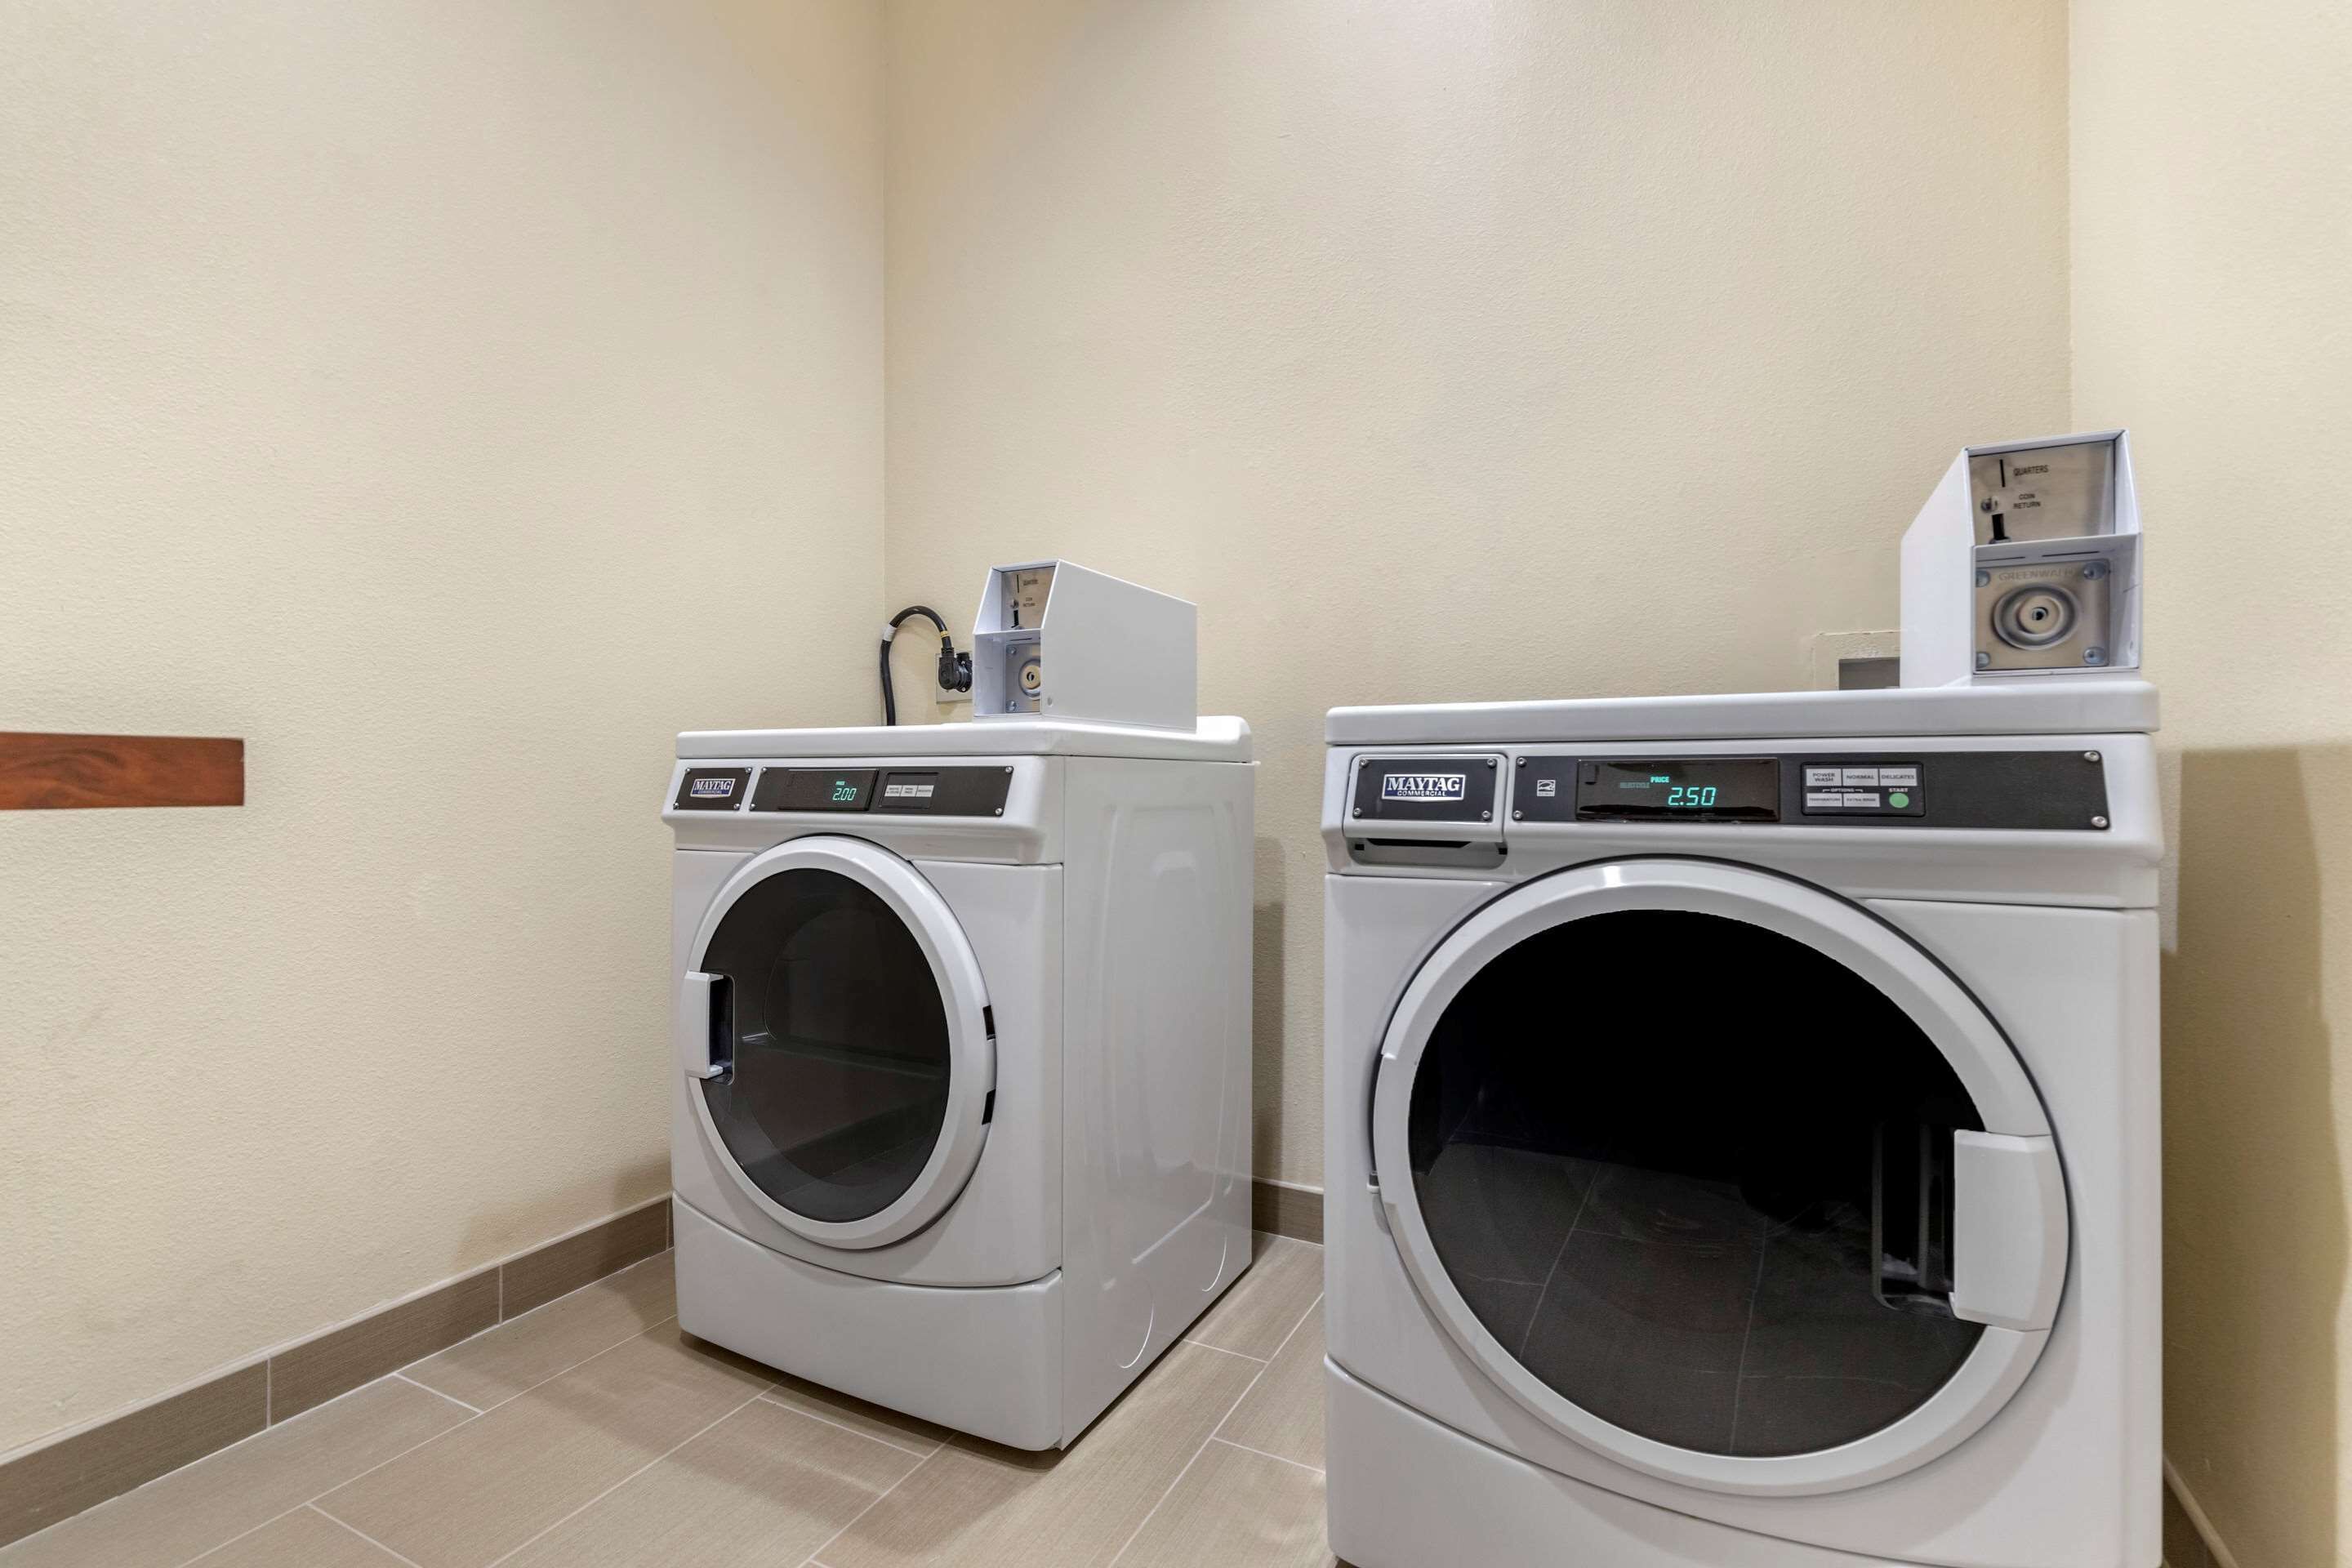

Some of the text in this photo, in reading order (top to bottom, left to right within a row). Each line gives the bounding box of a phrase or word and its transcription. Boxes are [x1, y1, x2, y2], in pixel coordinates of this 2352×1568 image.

[2013, 465, 2049, 476] QUARTERS
[694, 781, 732, 791] MAYTAG
[1387, 777, 1460, 791] MAYTAG
[832, 787, 857, 801] 2.00
[1668, 786, 1717, 806] 2.50
